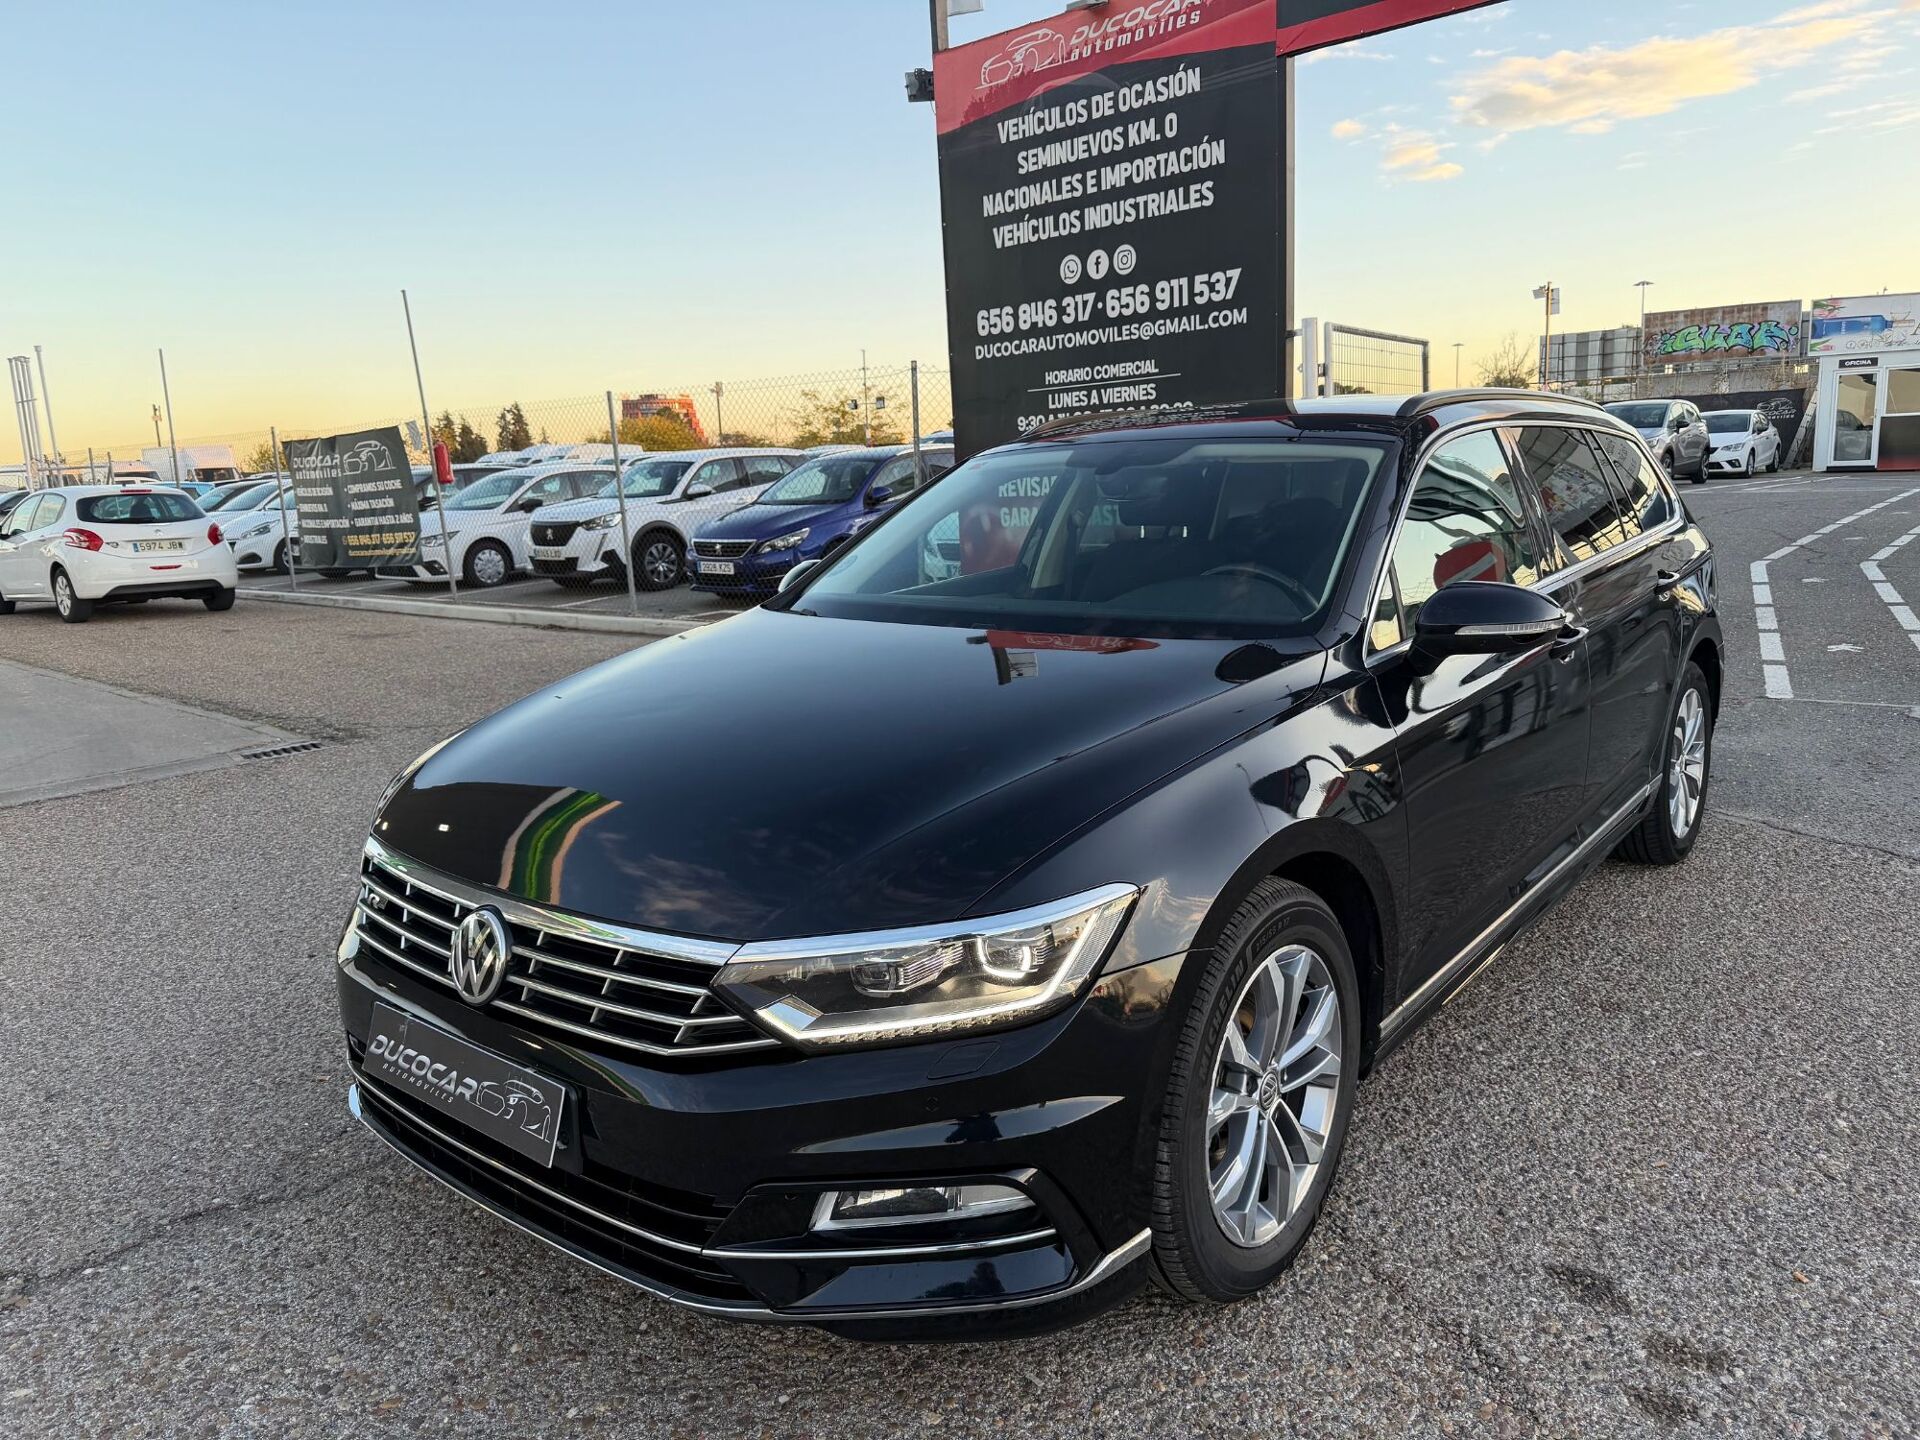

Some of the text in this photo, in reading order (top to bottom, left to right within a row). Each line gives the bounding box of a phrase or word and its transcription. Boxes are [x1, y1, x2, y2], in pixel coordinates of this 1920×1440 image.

[996, 63, 1200, 144] VEHÍCULOS DE OCASIÓN
[982, 135, 1225, 217] NACIONALES E IMPORTACIÓN
[1017, 126, 1124, 175] SEMINUEVOS
[1128, 117, 1160, 148] KM.
[992, 181, 1214, 249] VEHÍCULOS INDUSTRIALES
[975, 307, 1248, 360] DUCOCARAUTOMOVILES@GMAIL.COM
[977, 305, 1014, 337] 656
[1018, 298, 1058, 330] 846
[1155, 277, 1189, 311] 911
[1193, 267, 1242, 305] 537
[1045, 359, 1159, 385] HORARIO COMERCIAL
[1048, 383, 1157, 409] LUNES A VIERNES
[1844, 359, 1872, 367] OFICINA
[1199, 959, 1245, 1080] MICHELIN
[368, 1034, 479, 1102] DUCOCAR
